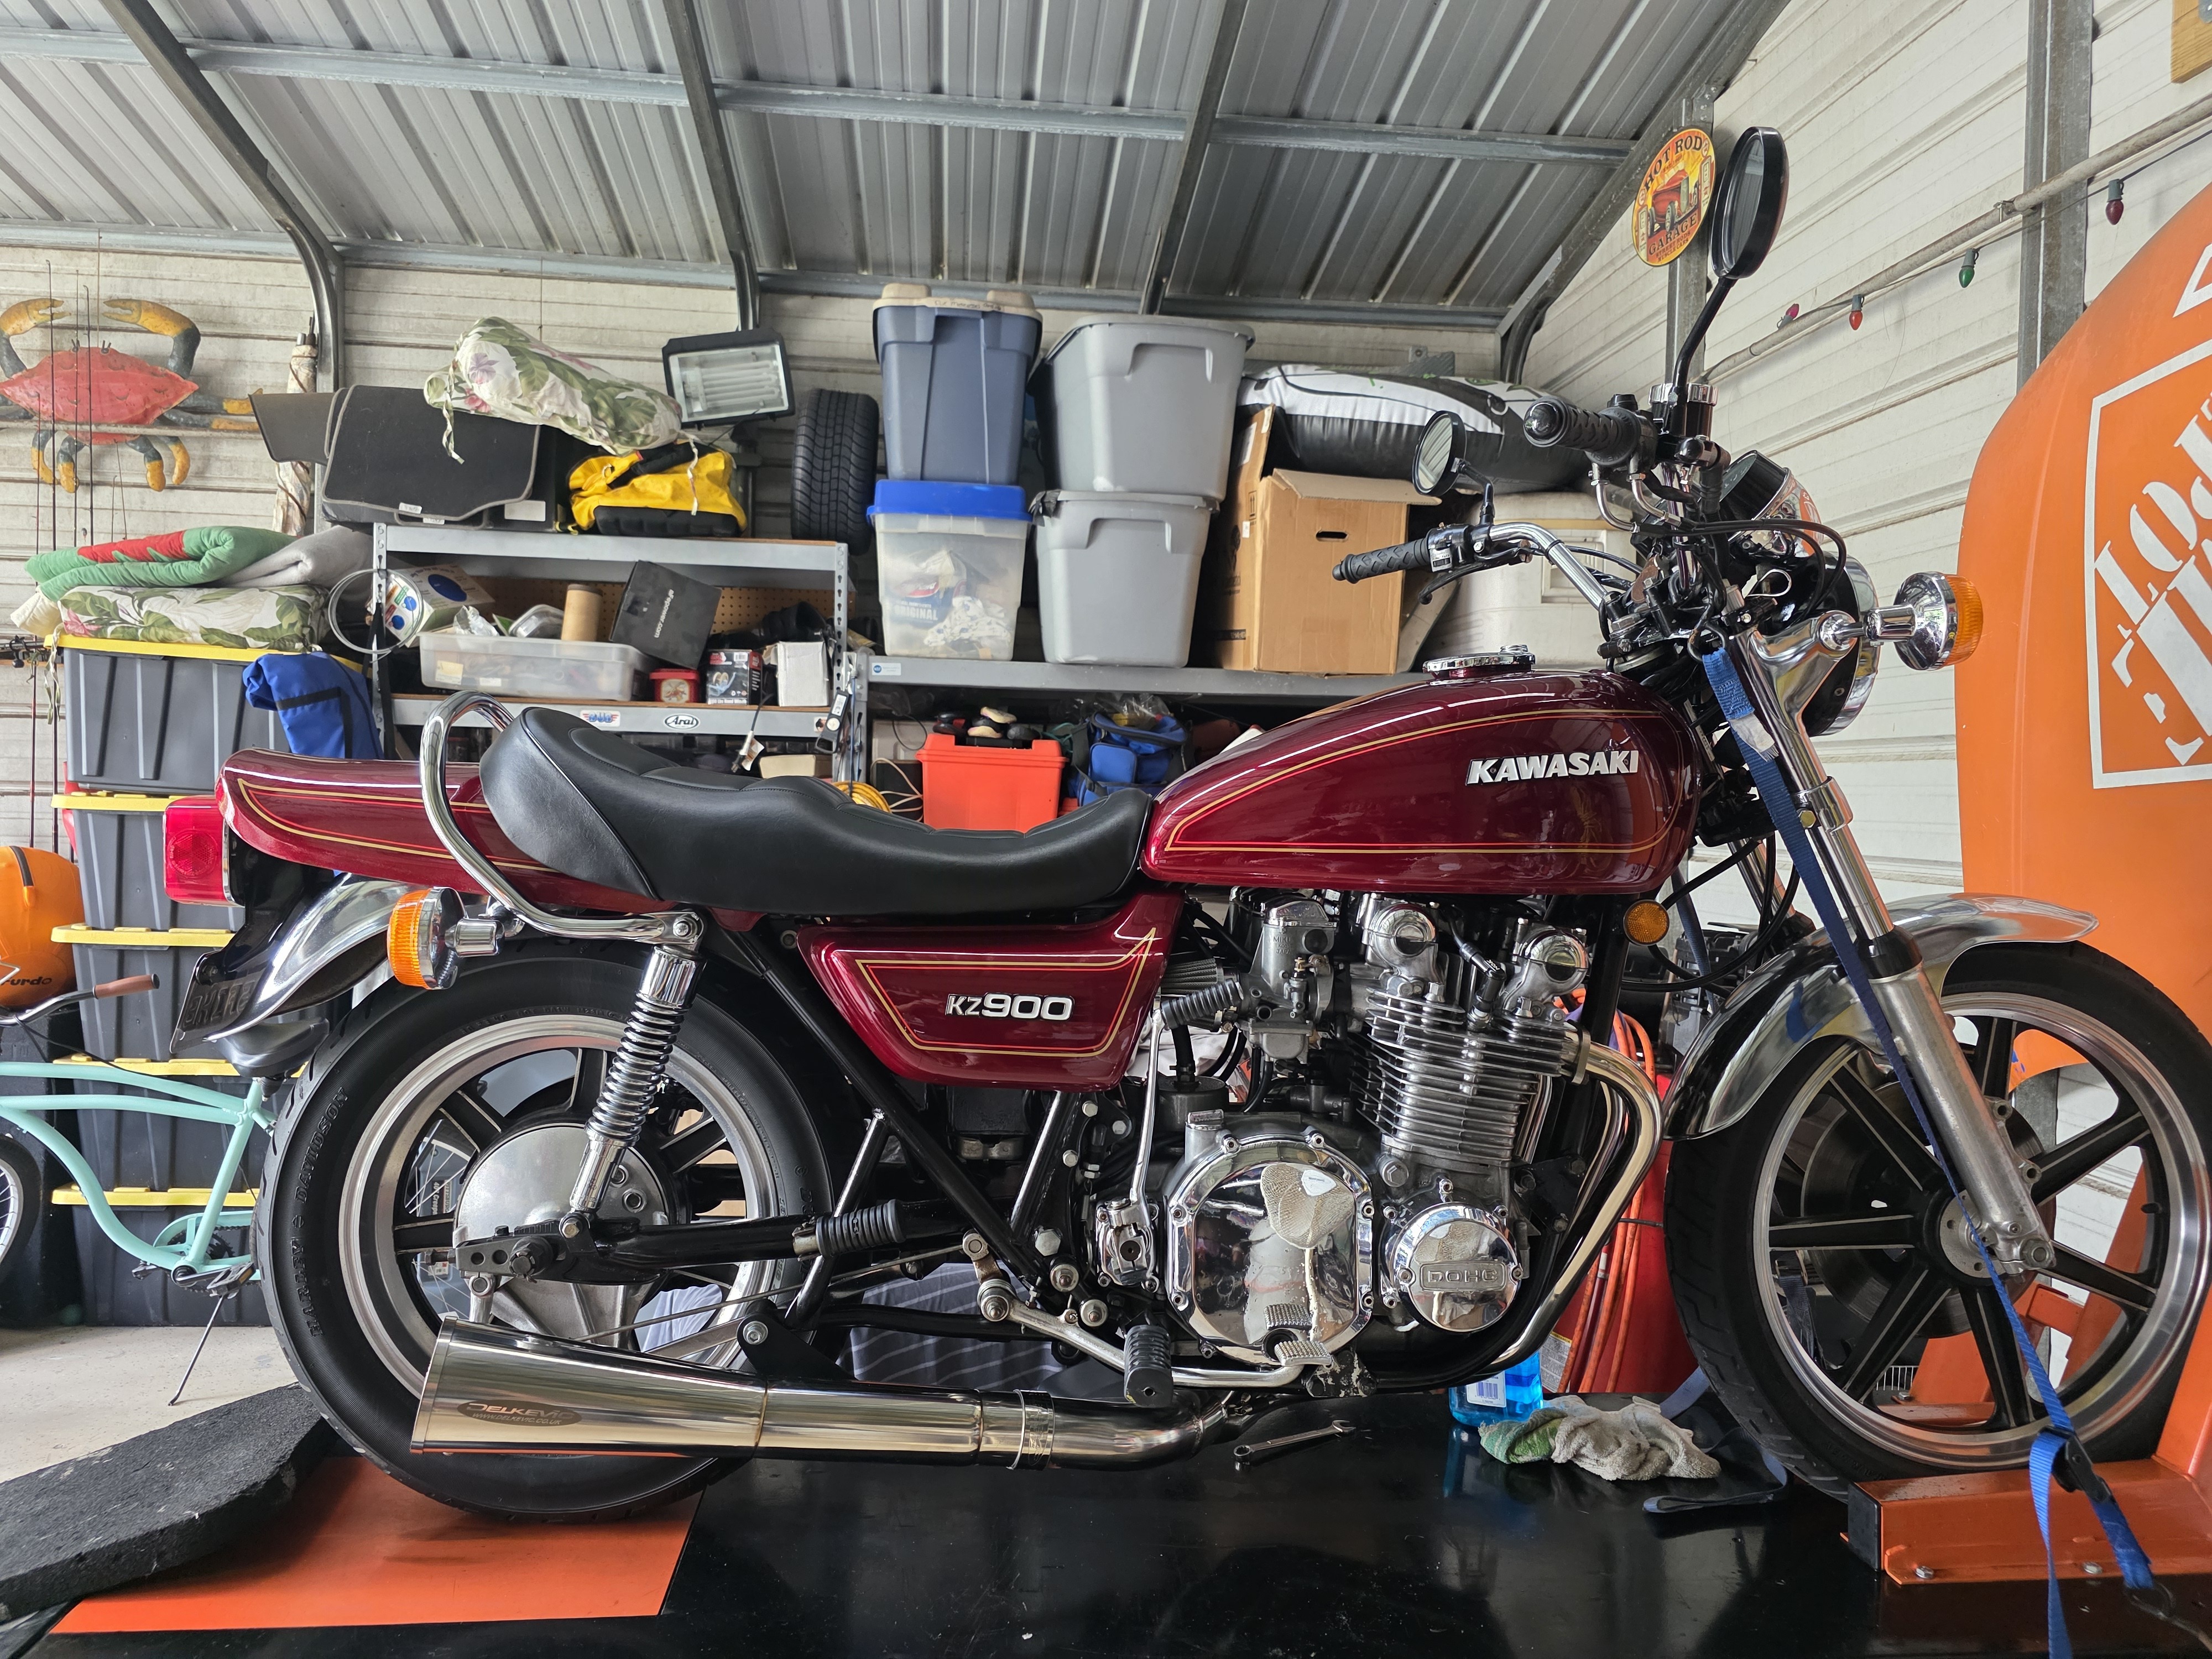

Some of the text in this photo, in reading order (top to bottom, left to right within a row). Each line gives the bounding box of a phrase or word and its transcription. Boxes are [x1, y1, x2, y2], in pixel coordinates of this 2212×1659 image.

[1644, 146, 1671, 192] HOT
[1674, 135, 1703, 155] ROD
[1648, 213, 1698, 255] GARAGE
[1656, 240, 1677, 259] STREET
[1658, 245, 1677, 263] MUSCLE
[1467, 750, 1639, 785] KAWASAKI
[947, 993, 1074, 1021] KZ900
[291, 1086, 349, 1337] HARLEY DAVIDSON
[431, 1194, 440, 1215] Creepe
[1427, 1269, 1498, 1283] DOHC
